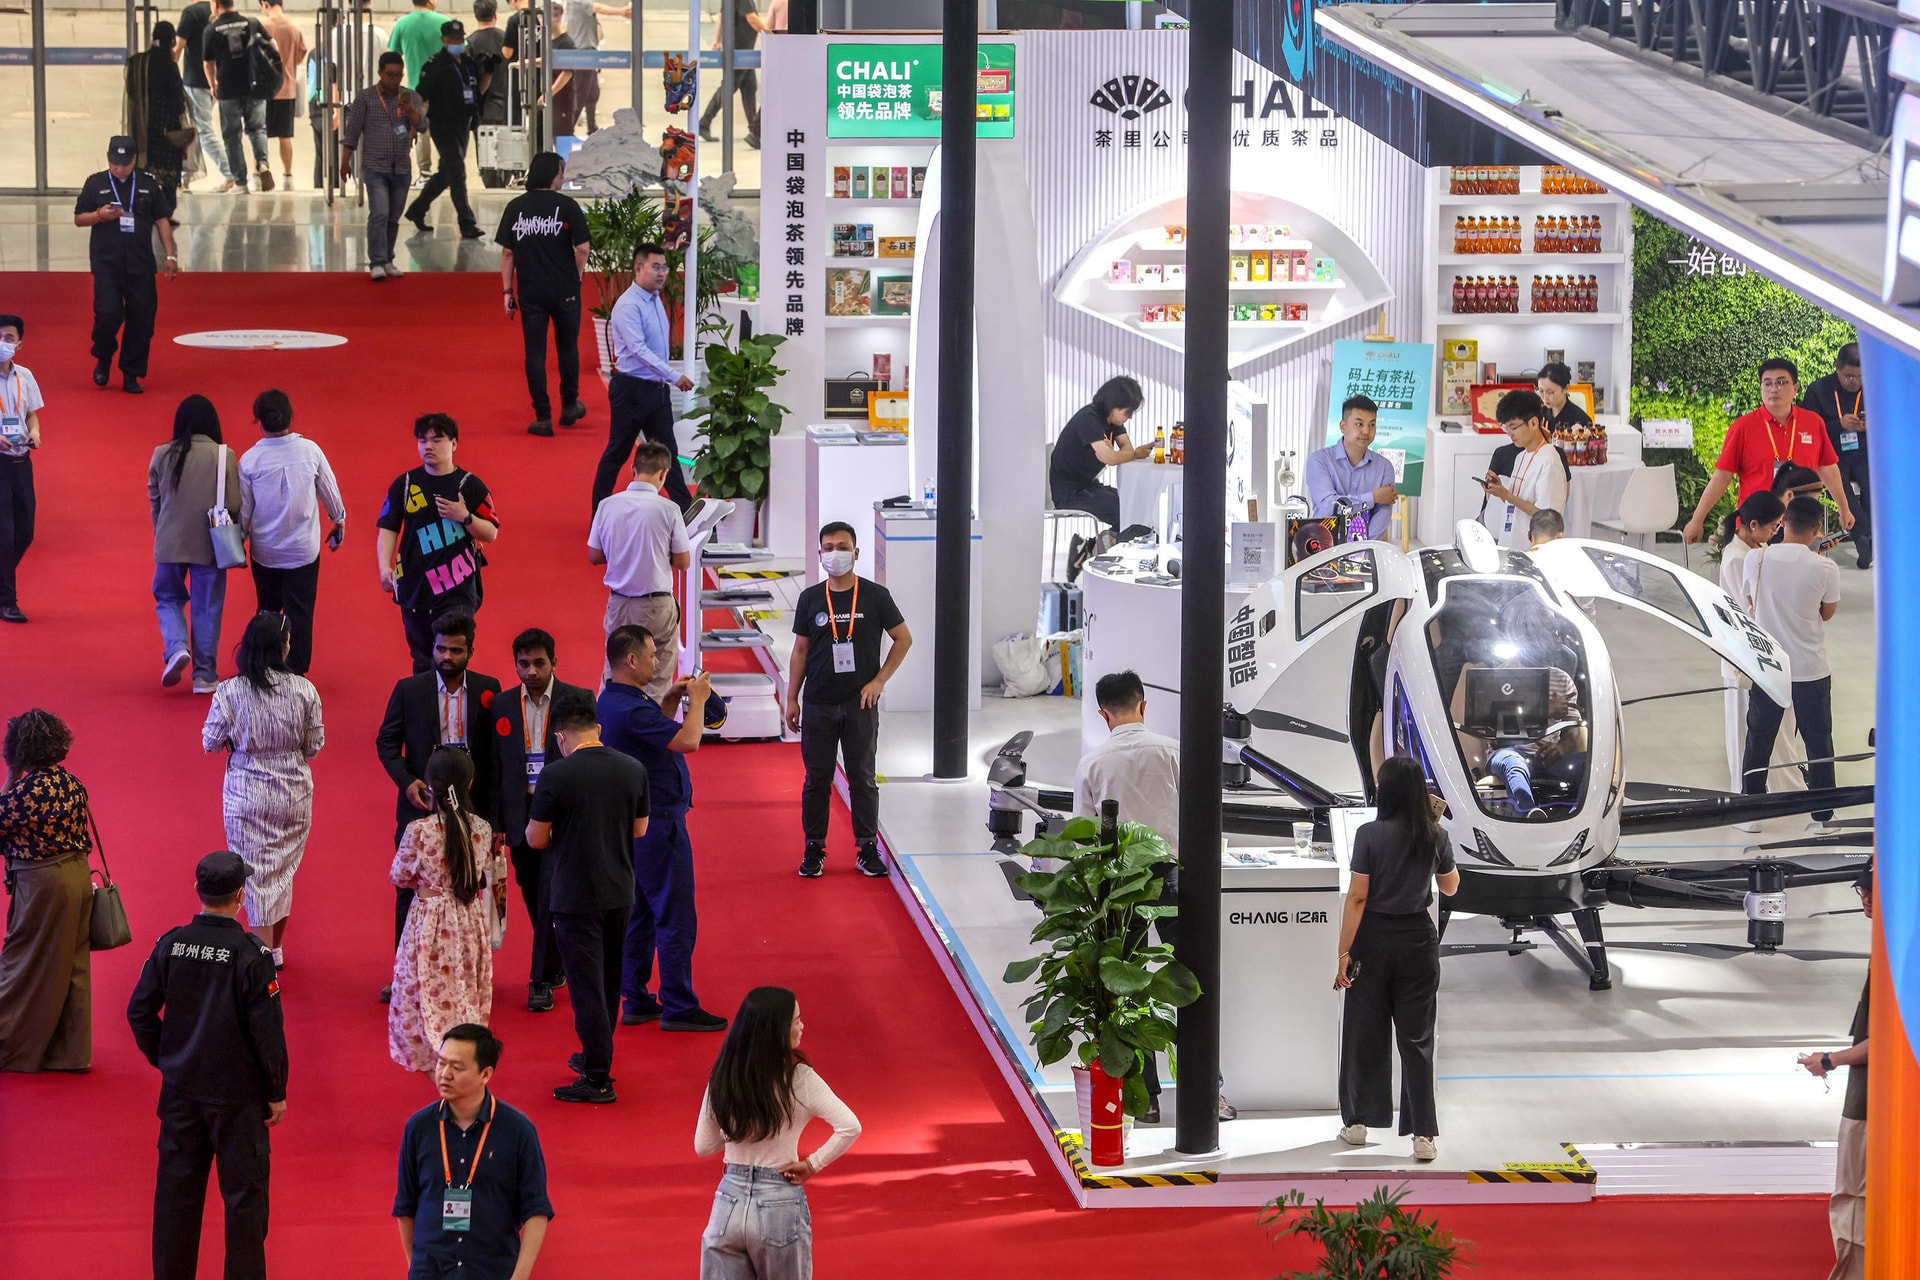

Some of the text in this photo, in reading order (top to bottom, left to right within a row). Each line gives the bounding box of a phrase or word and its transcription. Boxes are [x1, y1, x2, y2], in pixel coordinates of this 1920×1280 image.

[836, 60, 911, 80] CHALI
[837, 83, 912, 99] 中国袋泡茶
[837, 101, 912, 120] 领先品牌
[1232, 129, 1338, 148] 优质茶品
[785, 129, 805, 336] 中国袋泡茶领先品牌
[1348, 367, 1416, 384] 码上有茶礼
[1346, 382, 1415, 400] 快来抢先扫
[1228, 605, 1258, 688] 中国智造
[1296, 911, 1328, 924] 亿航
